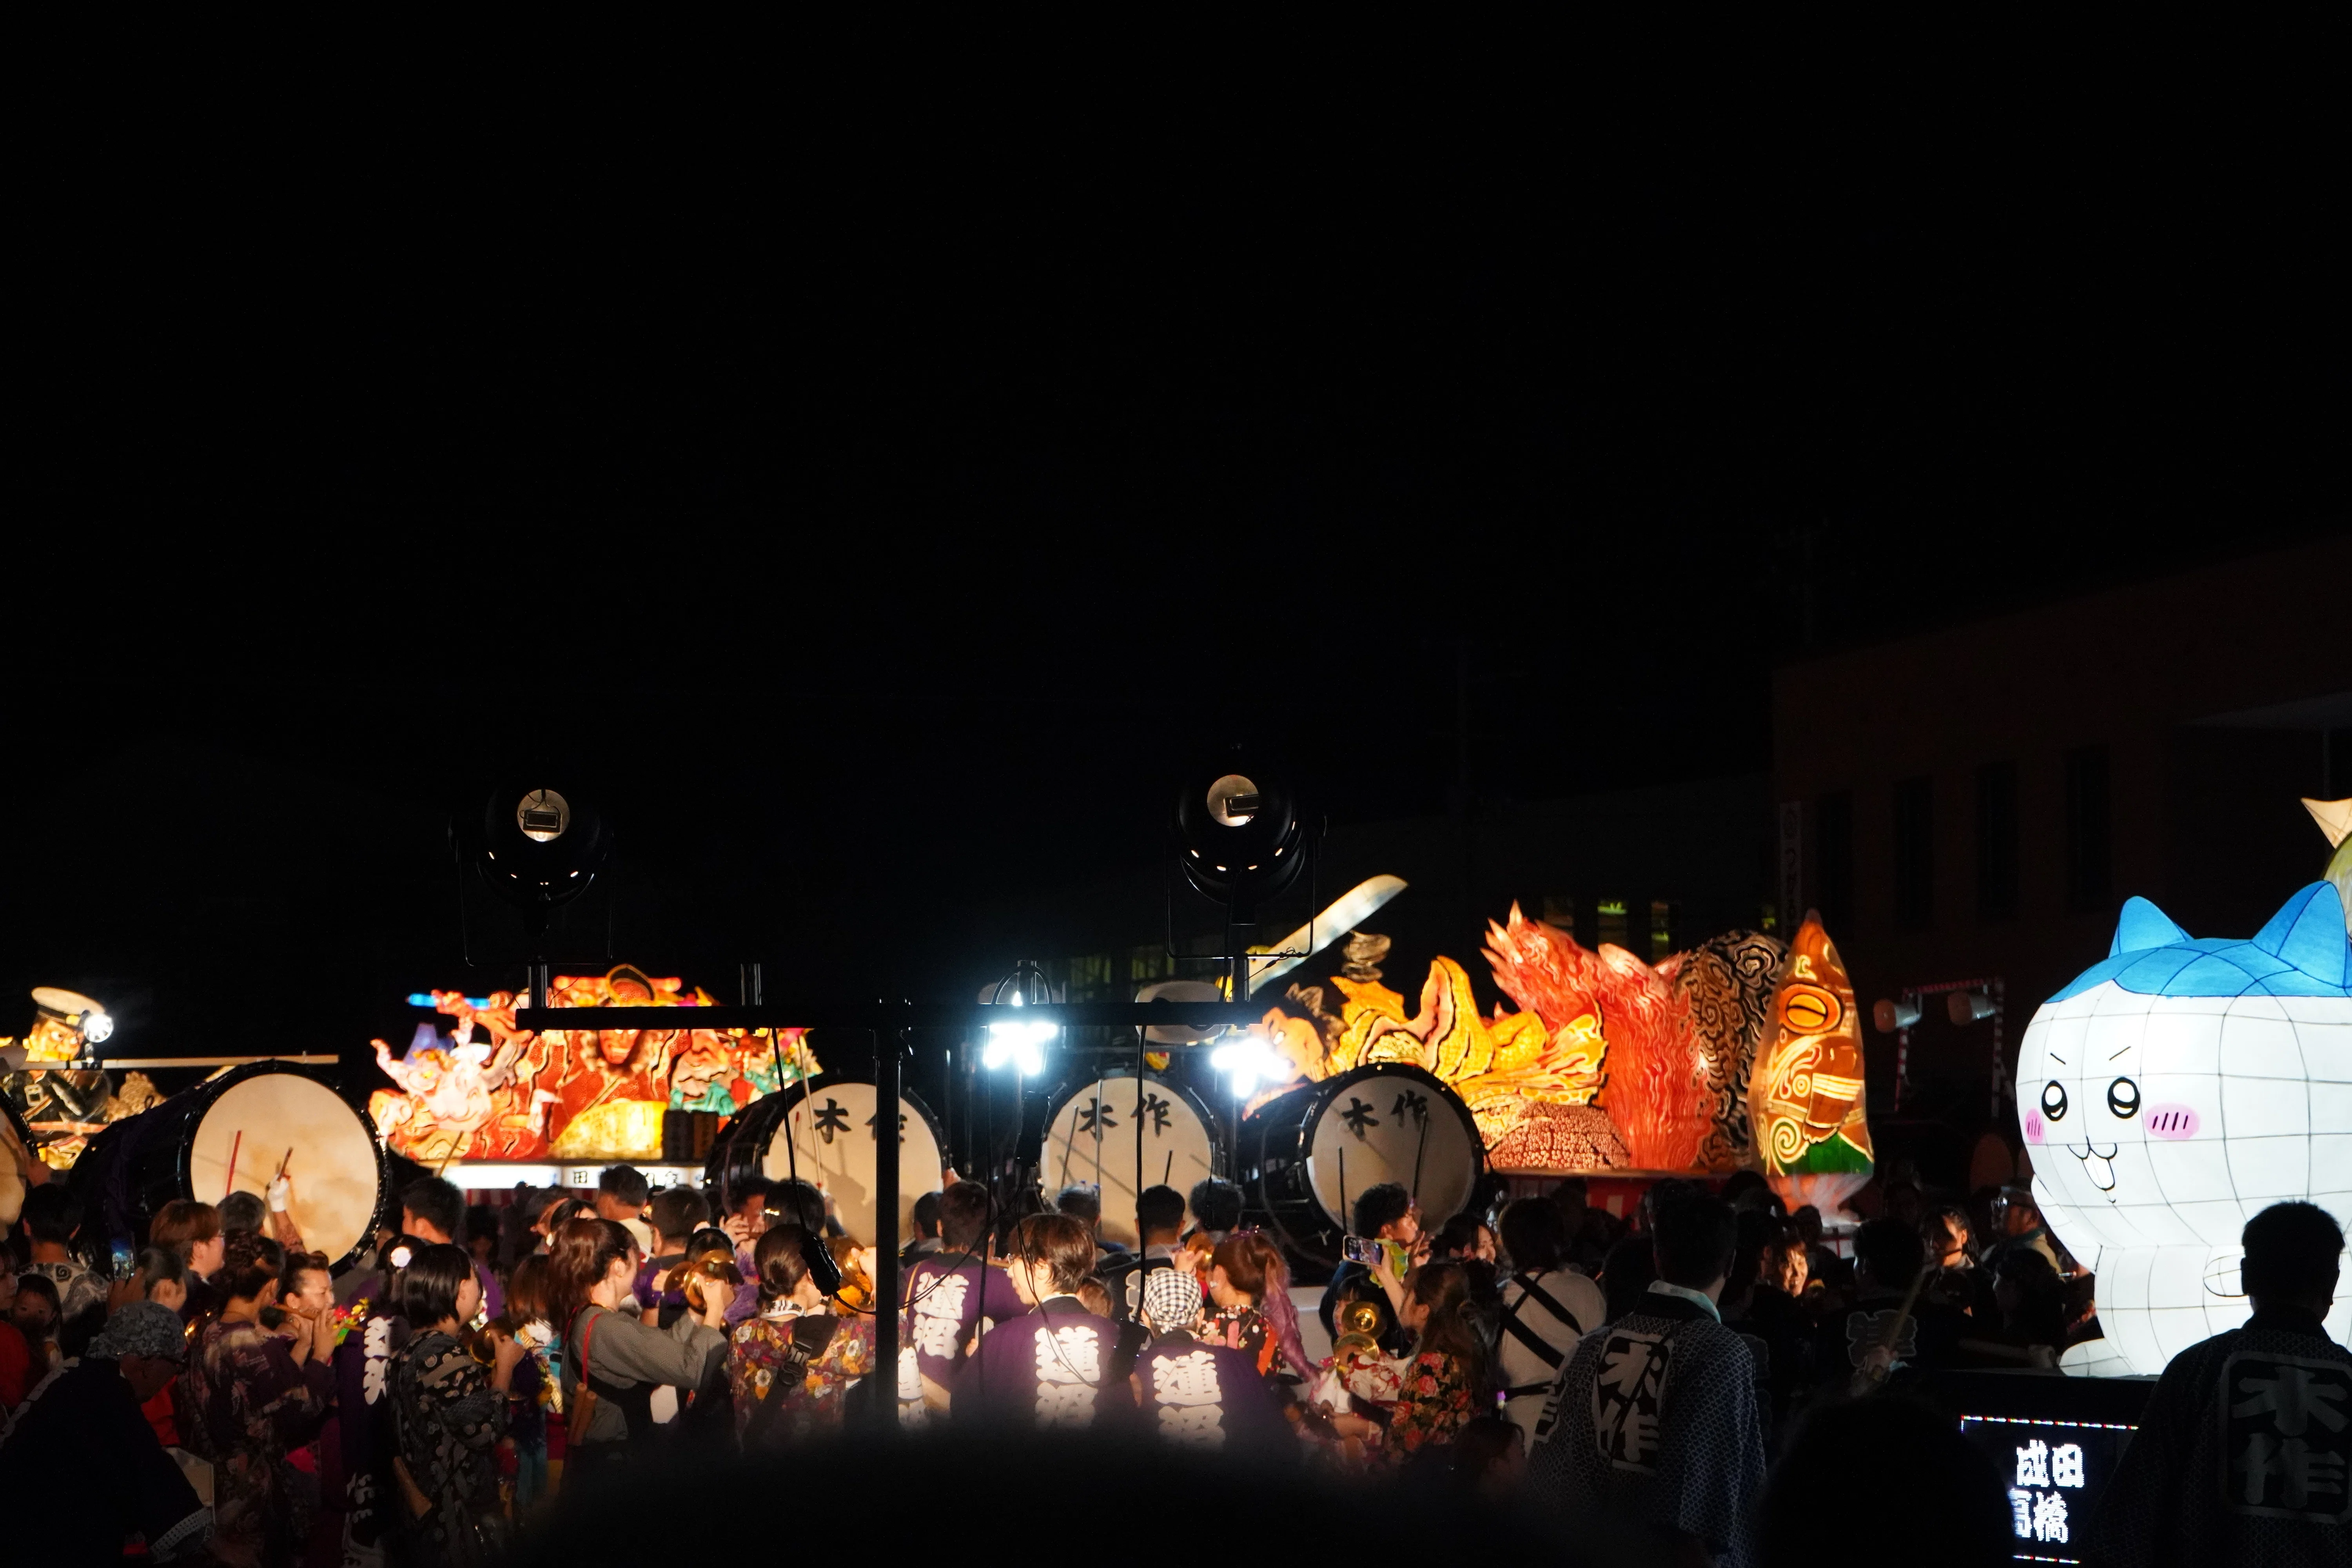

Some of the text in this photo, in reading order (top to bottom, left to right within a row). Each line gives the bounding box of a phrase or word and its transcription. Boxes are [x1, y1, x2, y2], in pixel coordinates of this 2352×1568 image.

[1079, 1094, 1172, 1142] 木作
[1342, 1090, 1431, 1141] 木作
[1599, 1342, 1661, 1463] 木作
[2231, 1365, 2351, 1509] 木作
[2016, 1439, 2085, 1488] 成田
